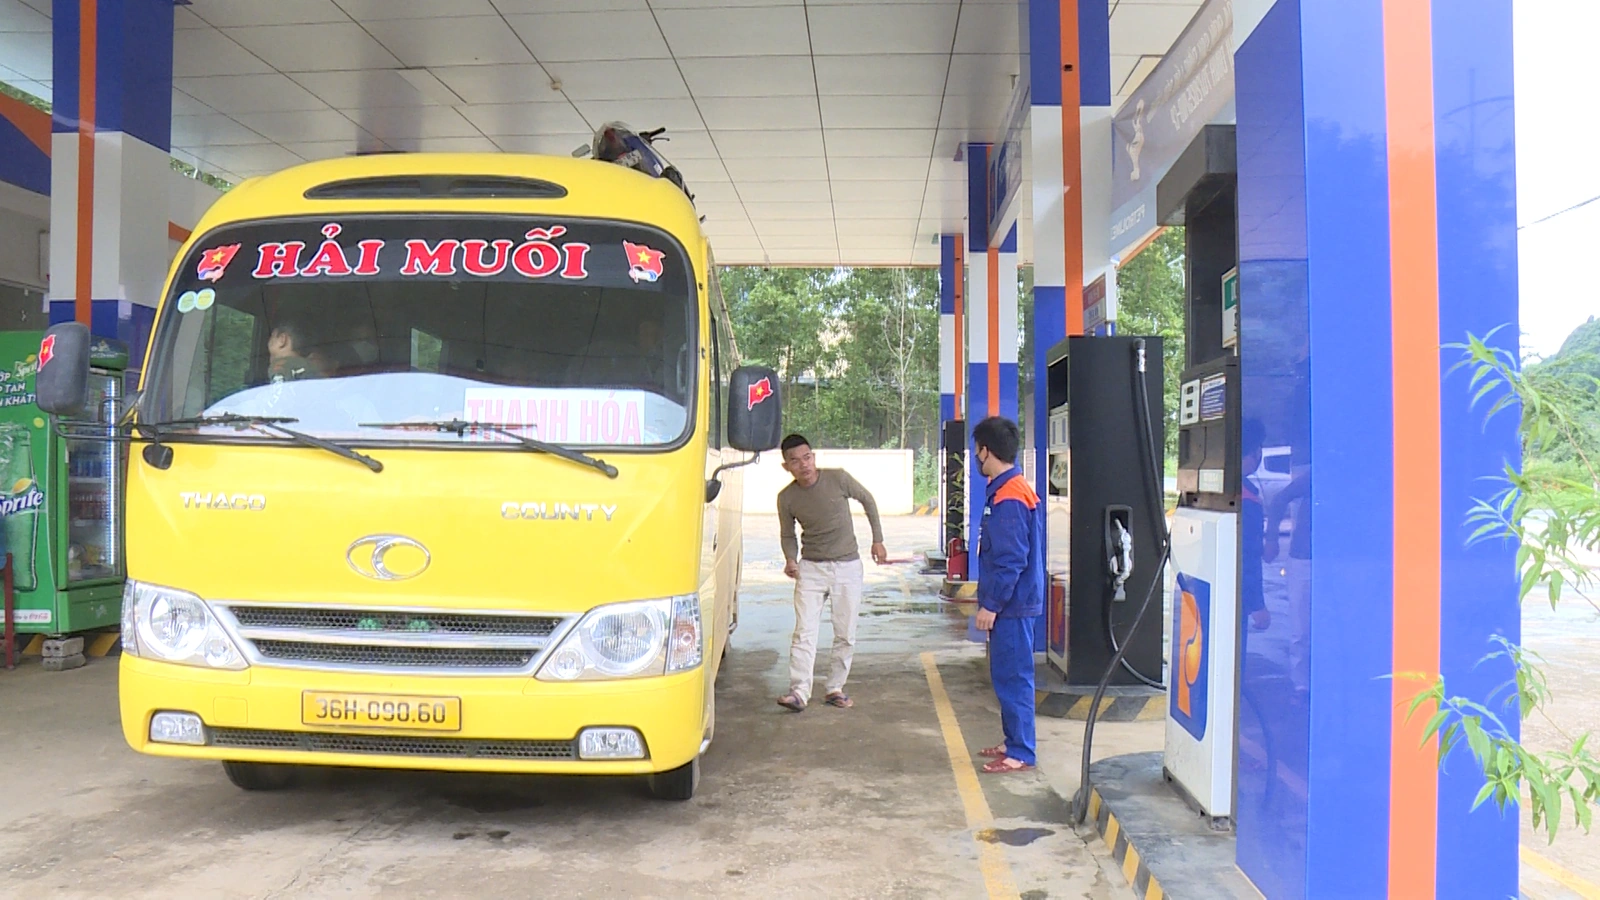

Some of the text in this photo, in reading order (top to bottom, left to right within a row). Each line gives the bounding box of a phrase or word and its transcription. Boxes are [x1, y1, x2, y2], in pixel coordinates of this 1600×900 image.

[252, 223, 592, 281] HẢI MUỐI
[5, 382, 26, 394] TAN
[467, 392, 642, 444] THANH HÓA
[180, 491, 618, 522] THACO COUNTY
[316, 698, 446, 724] 36H-090.60
